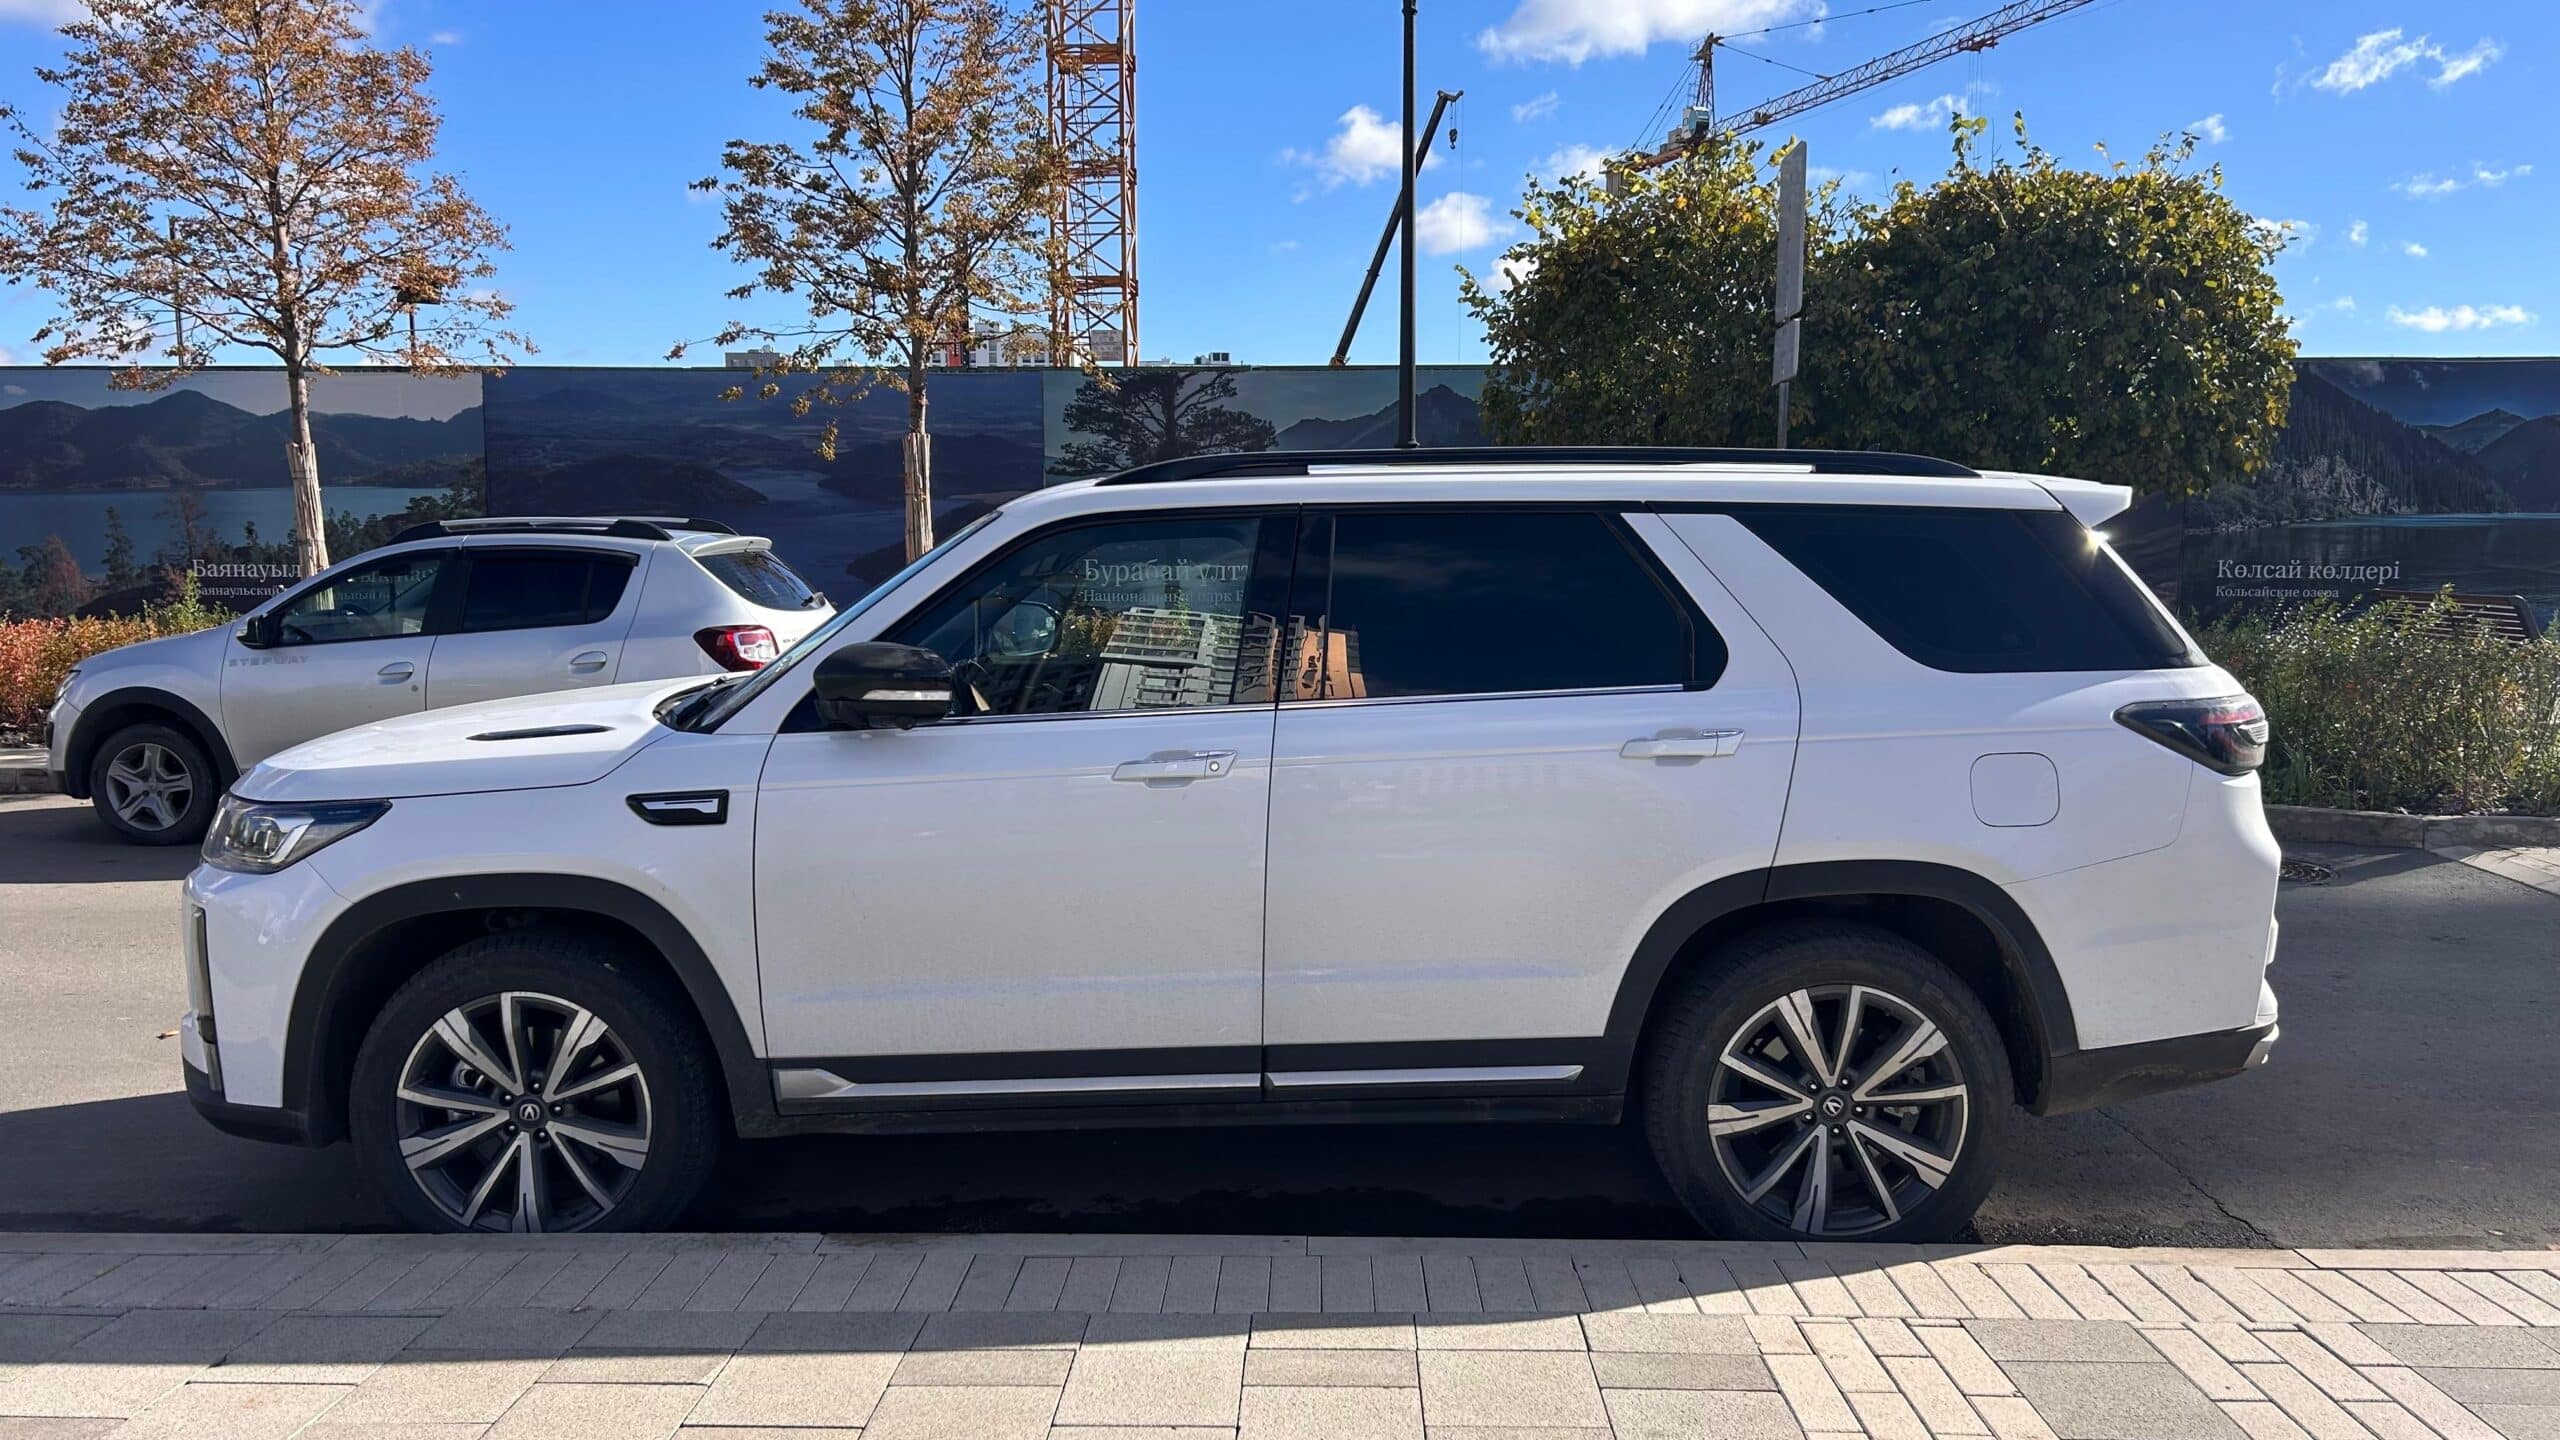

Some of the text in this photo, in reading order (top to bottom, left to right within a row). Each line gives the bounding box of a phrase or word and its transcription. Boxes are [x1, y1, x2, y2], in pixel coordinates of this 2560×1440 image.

[191, 559, 302, 583] Баянауыл
[1083, 558, 1191, 587] Бурабай
[2216, 559, 2401, 585] Көлсай көлдері
[2215, 585, 2300, 598] Кольсайские
